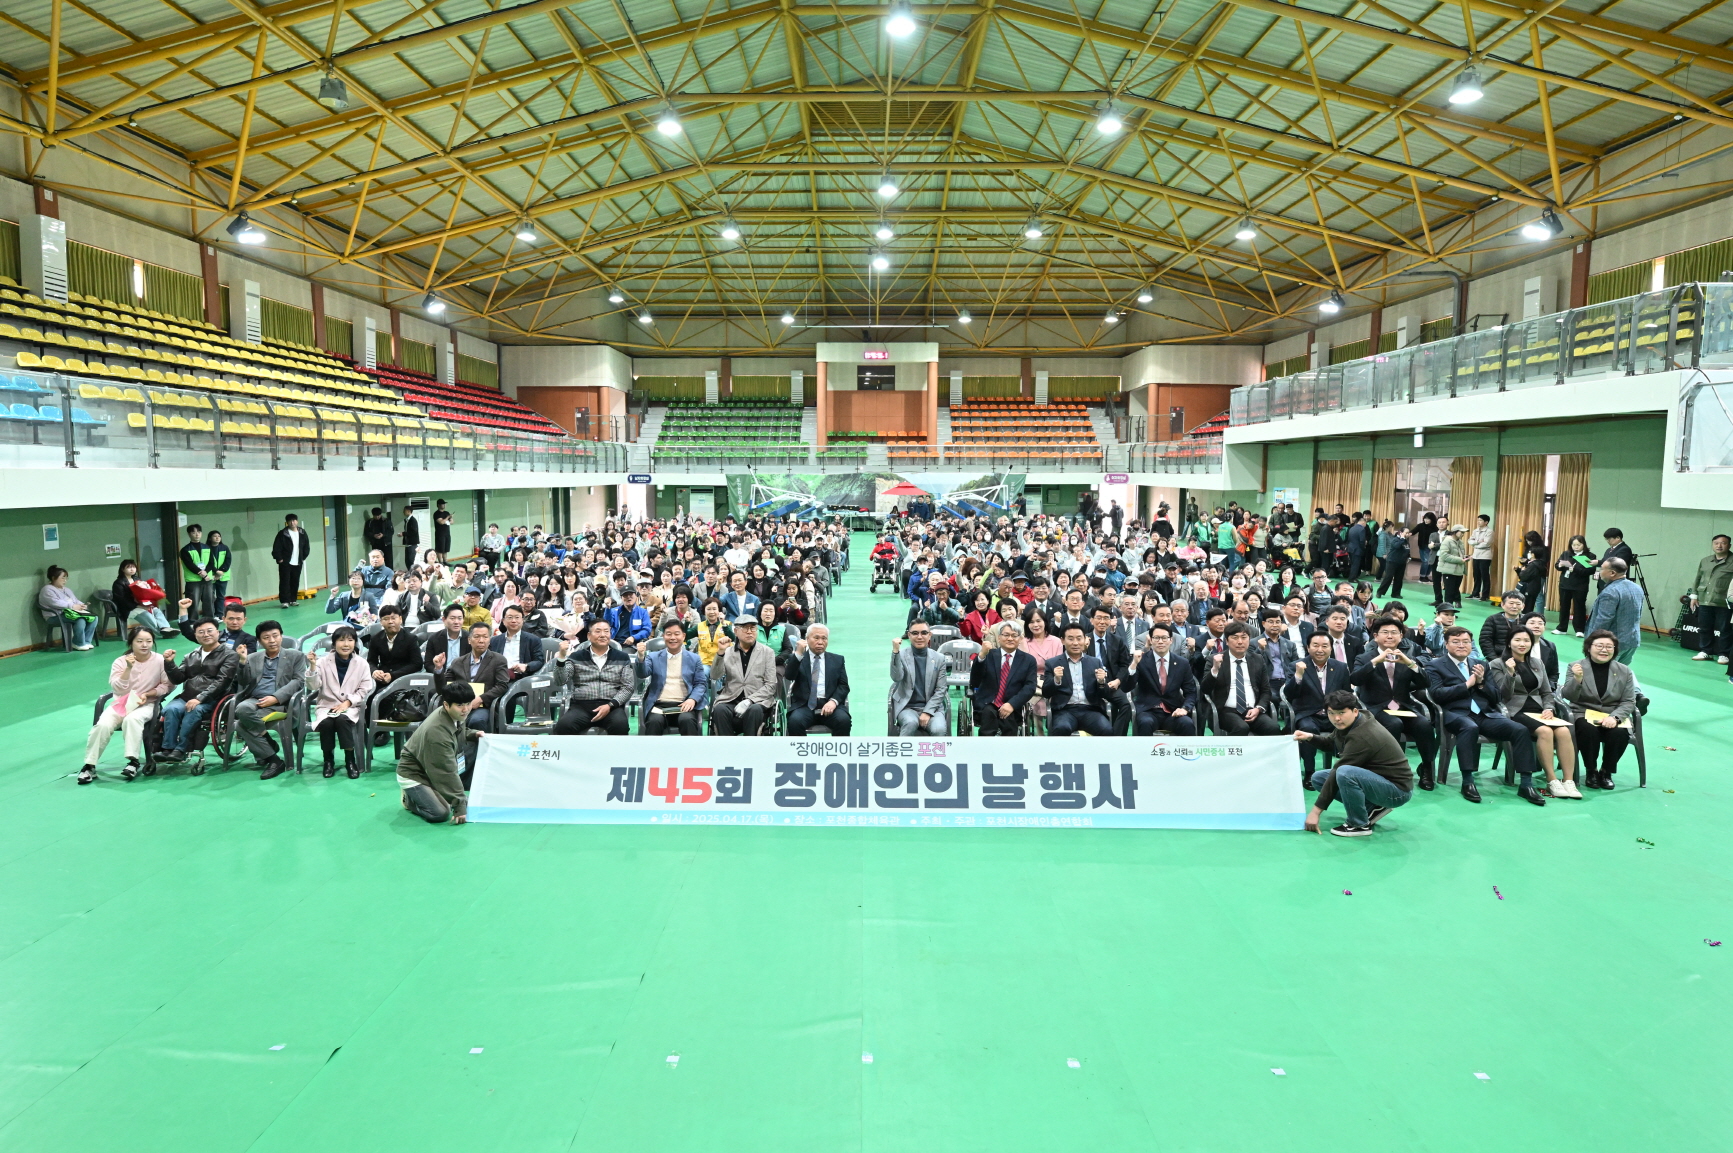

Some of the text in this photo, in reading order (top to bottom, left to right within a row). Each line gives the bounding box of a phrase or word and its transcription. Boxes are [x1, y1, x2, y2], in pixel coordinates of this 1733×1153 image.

[530, 749, 561, 761] 포천시
[790, 741, 853, 757] “장애인이
[856, 741, 914, 757] 살기좋은
[1150, 747, 1171, 756] 소통과
[1195, 747, 1226, 757] 시민중심
[1228, 747, 1244, 756] 포천
[606, 762, 1139, 810] 제45회 장애인의 날 행사
[826, 814, 901, 825] 포천종합체육관
